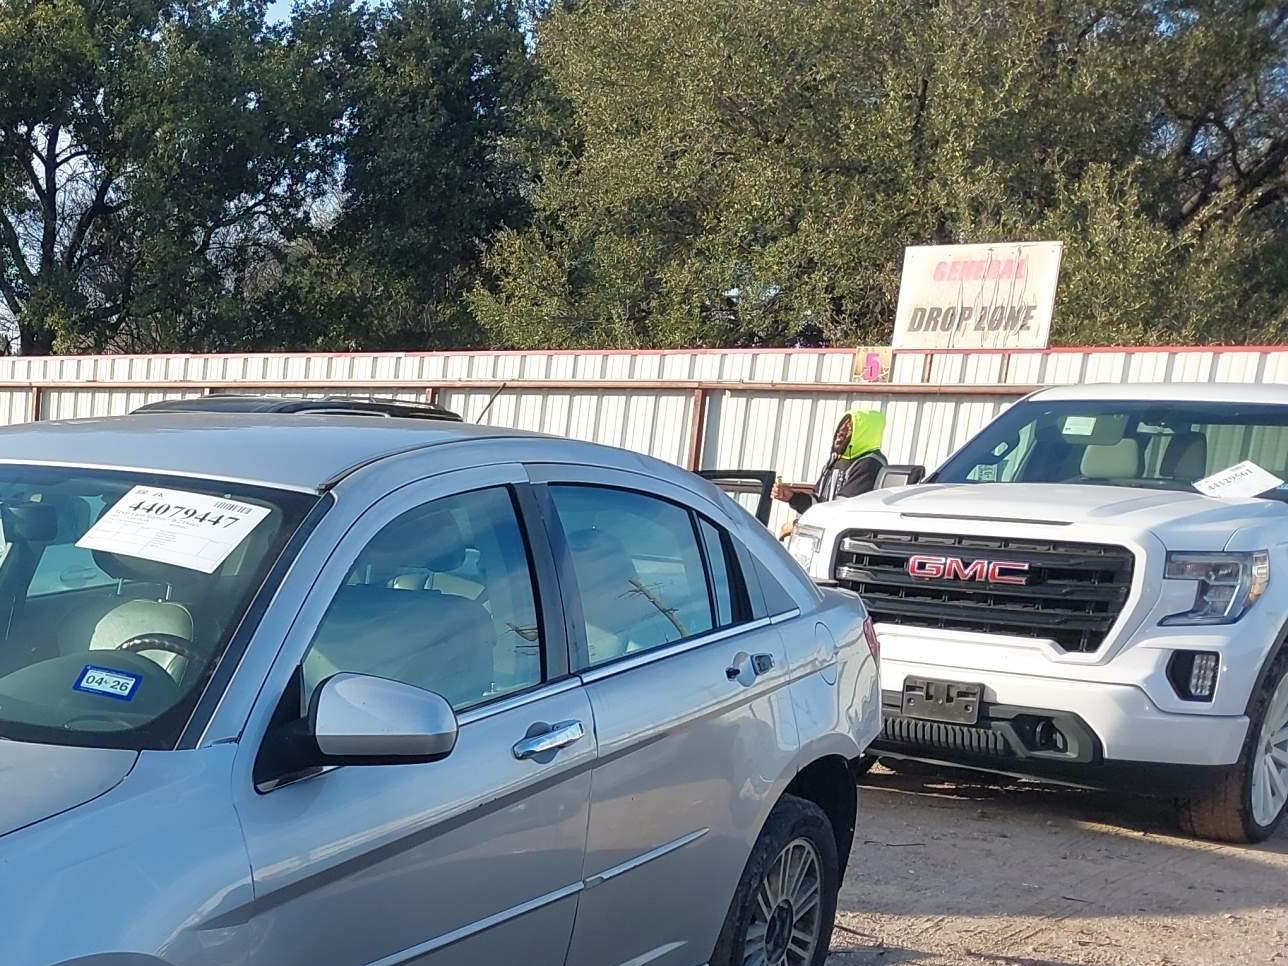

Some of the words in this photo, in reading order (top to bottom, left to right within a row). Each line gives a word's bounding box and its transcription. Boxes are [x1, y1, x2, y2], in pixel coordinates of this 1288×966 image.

[907, 306, 974, 333] DROP
[973, 304, 1038, 332] ZONE
[128, 500, 241, 529] 44079447
[907, 555, 1030, 585] GMC
